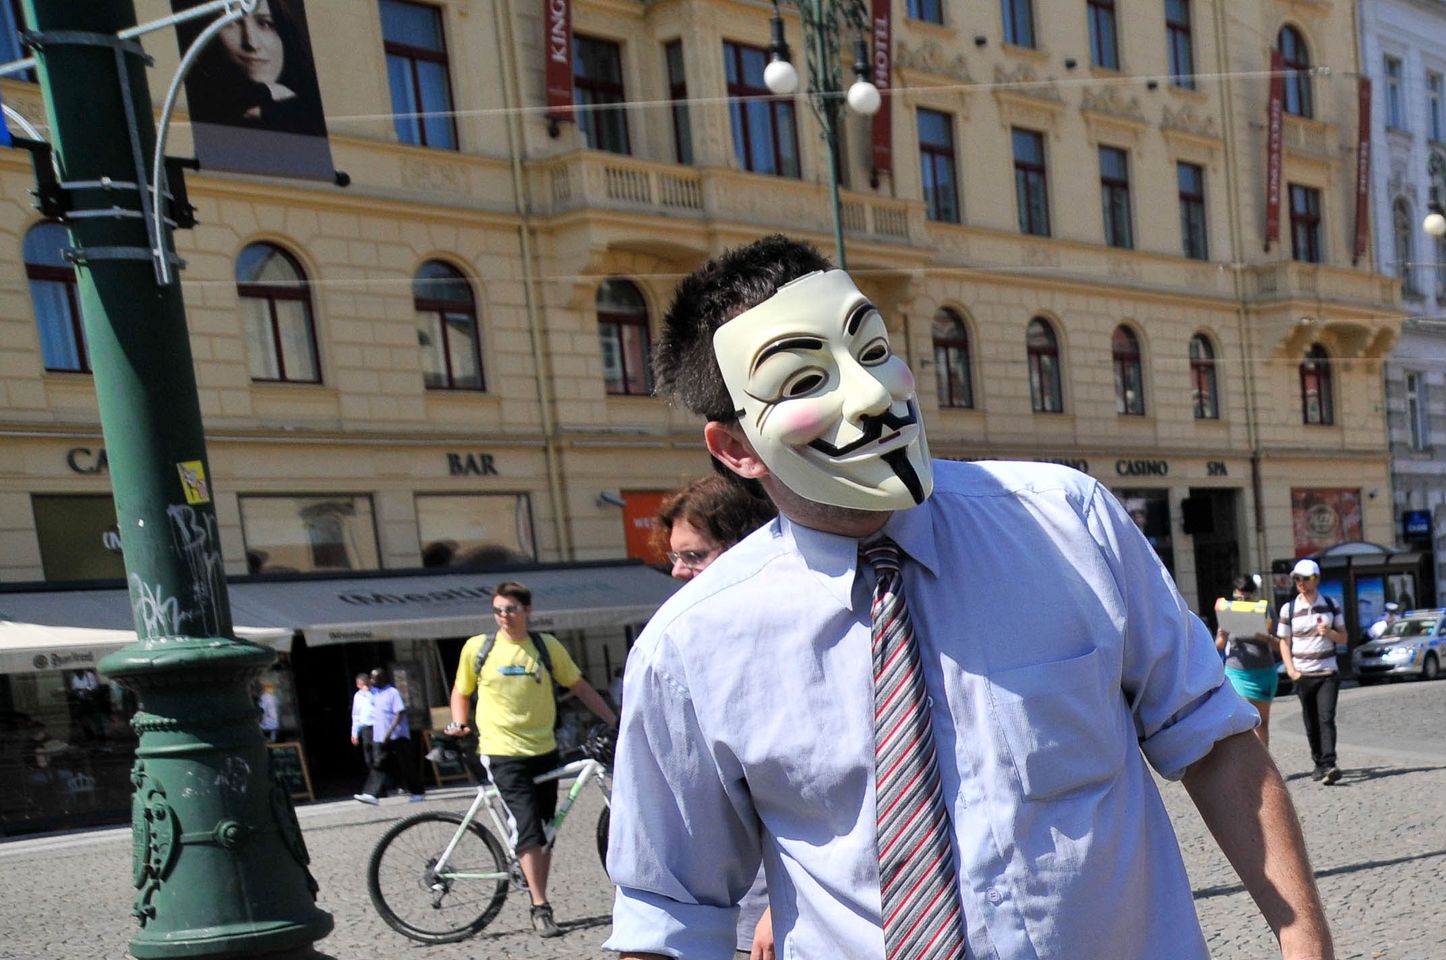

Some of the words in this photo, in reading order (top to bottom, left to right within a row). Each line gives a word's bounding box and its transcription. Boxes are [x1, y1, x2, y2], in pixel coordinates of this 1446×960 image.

[446, 452, 498, 476] BAR
[1115, 459, 1169, 477] CASINO
[1206, 461, 1228, 476] SPA
